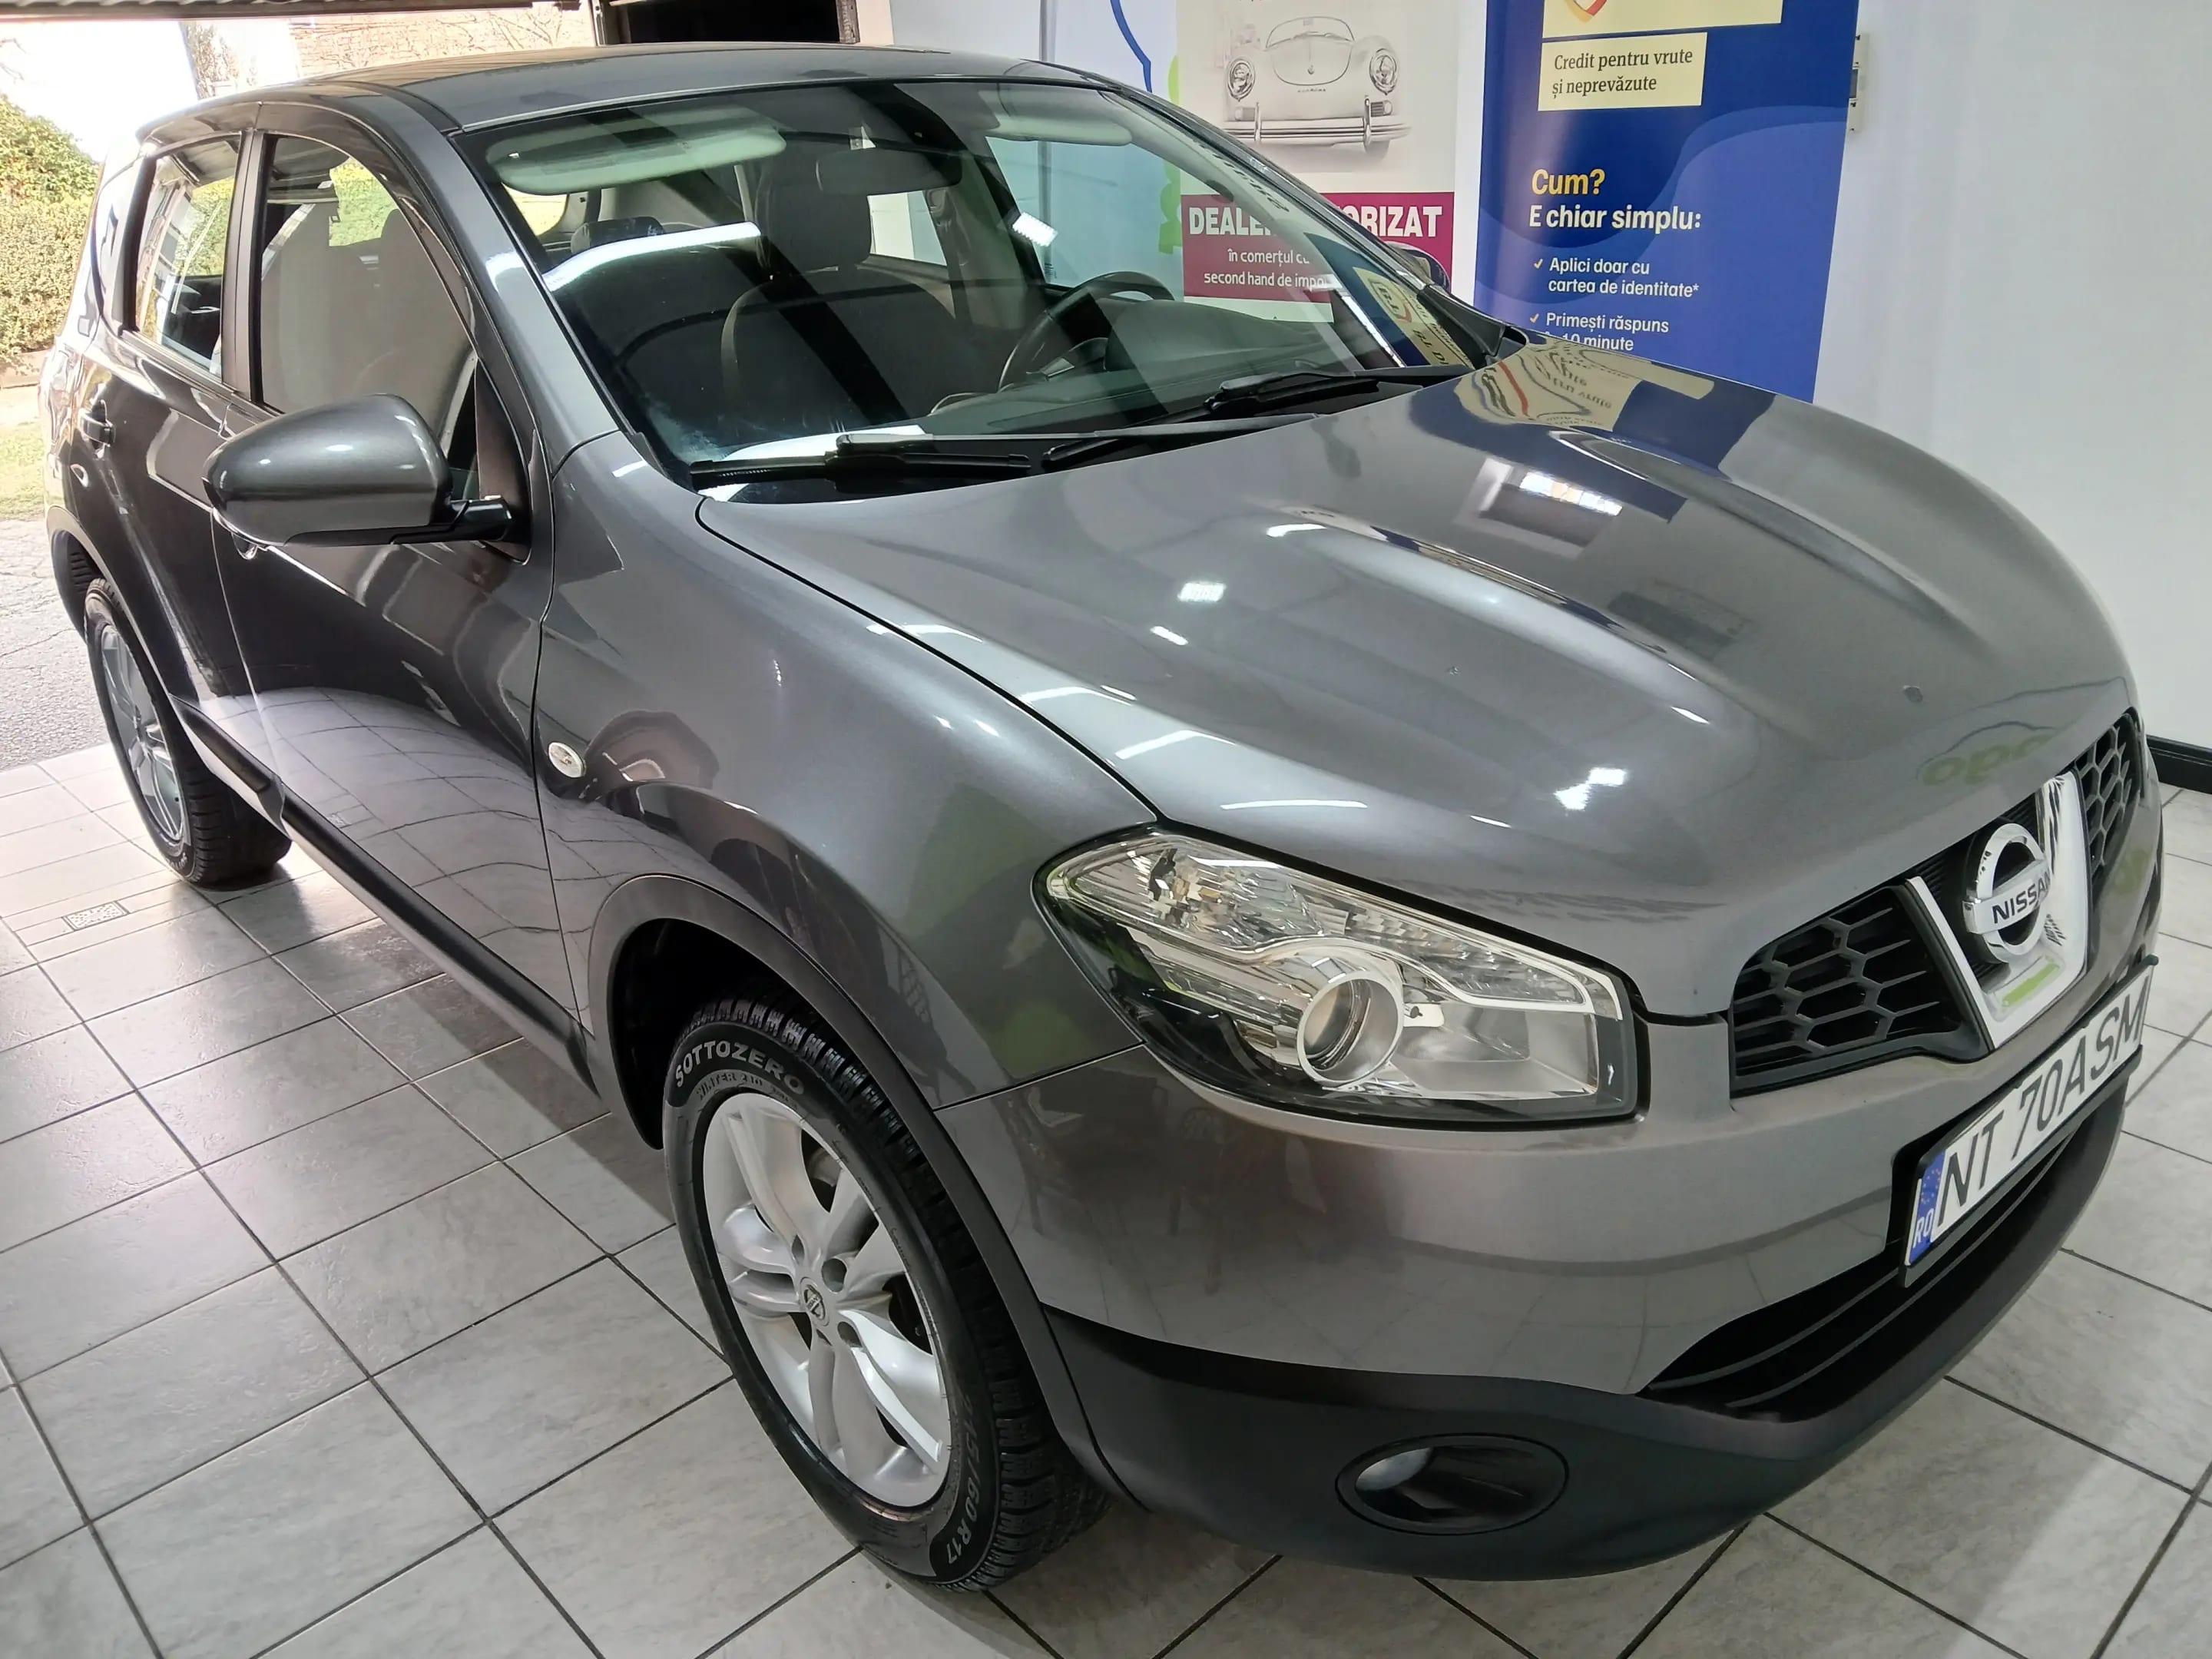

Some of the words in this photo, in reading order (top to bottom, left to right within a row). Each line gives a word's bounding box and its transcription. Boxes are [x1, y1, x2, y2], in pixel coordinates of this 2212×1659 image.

[1554, 52, 1595, 70] Credit
[1598, 51, 1650, 71] pentru
[1654, 48, 1694, 65] vrute
[1551, 78, 1563, 98] și
[1566, 75, 1657, 97] neprevăzute
[1532, 168, 1606, 195] Cum?
[1189, 207, 1271, 236] DEALE
[1339, 205, 1443, 237] RIZAT
[1529, 204, 1543, 227] E
[1545, 204, 1608, 228] chiar
[1611, 204, 1701, 234] simplu:
[1227, 248, 1239, 263] în
[1240, 249, 1293, 267] comerțul
[1549, 257, 1590, 275] Aplici
[1593, 258, 1628, 274] doar
[1631, 262, 1650, 275] cu
[1204, 271, 1246, 285] second
[1247, 271, 1274, 286] hand
[1277, 272, 1293, 287] de
[1548, 280, 1596, 293] cartea
[1599, 280, 1618, 294] de
[1545, 312, 1606, 332] Primești
[1609, 315, 1669, 334] răspuns
[1584, 334, 1634, 351] minute
[1992, 871, 2051, 924] NISSAN
[674, 1040, 805, 1095] SOTTOZERO
[1936, 1110, 2005, 1228] NT
[1912, 1208, 1935, 1250] RO
